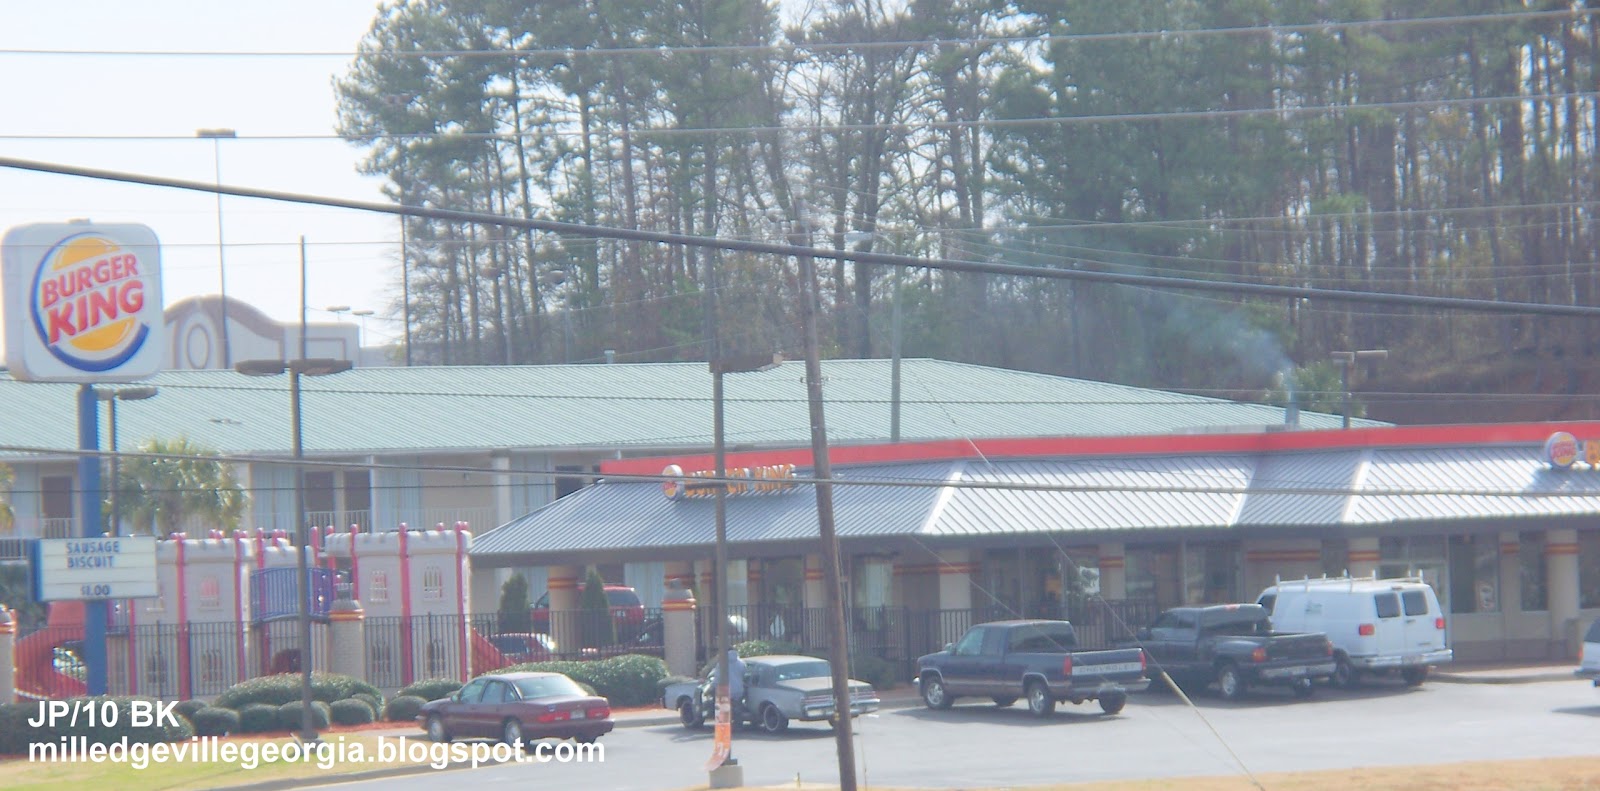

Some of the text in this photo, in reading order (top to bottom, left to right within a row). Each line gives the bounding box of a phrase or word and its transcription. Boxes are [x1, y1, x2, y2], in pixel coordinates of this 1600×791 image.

[41, 253, 139, 309] BURGER
[48, 279, 144, 345] KING
[66, 541, 120, 554] SAUSAGE
[67, 556, 114, 568] BISCUIT
[80, 585, 111, 596] $1.00
